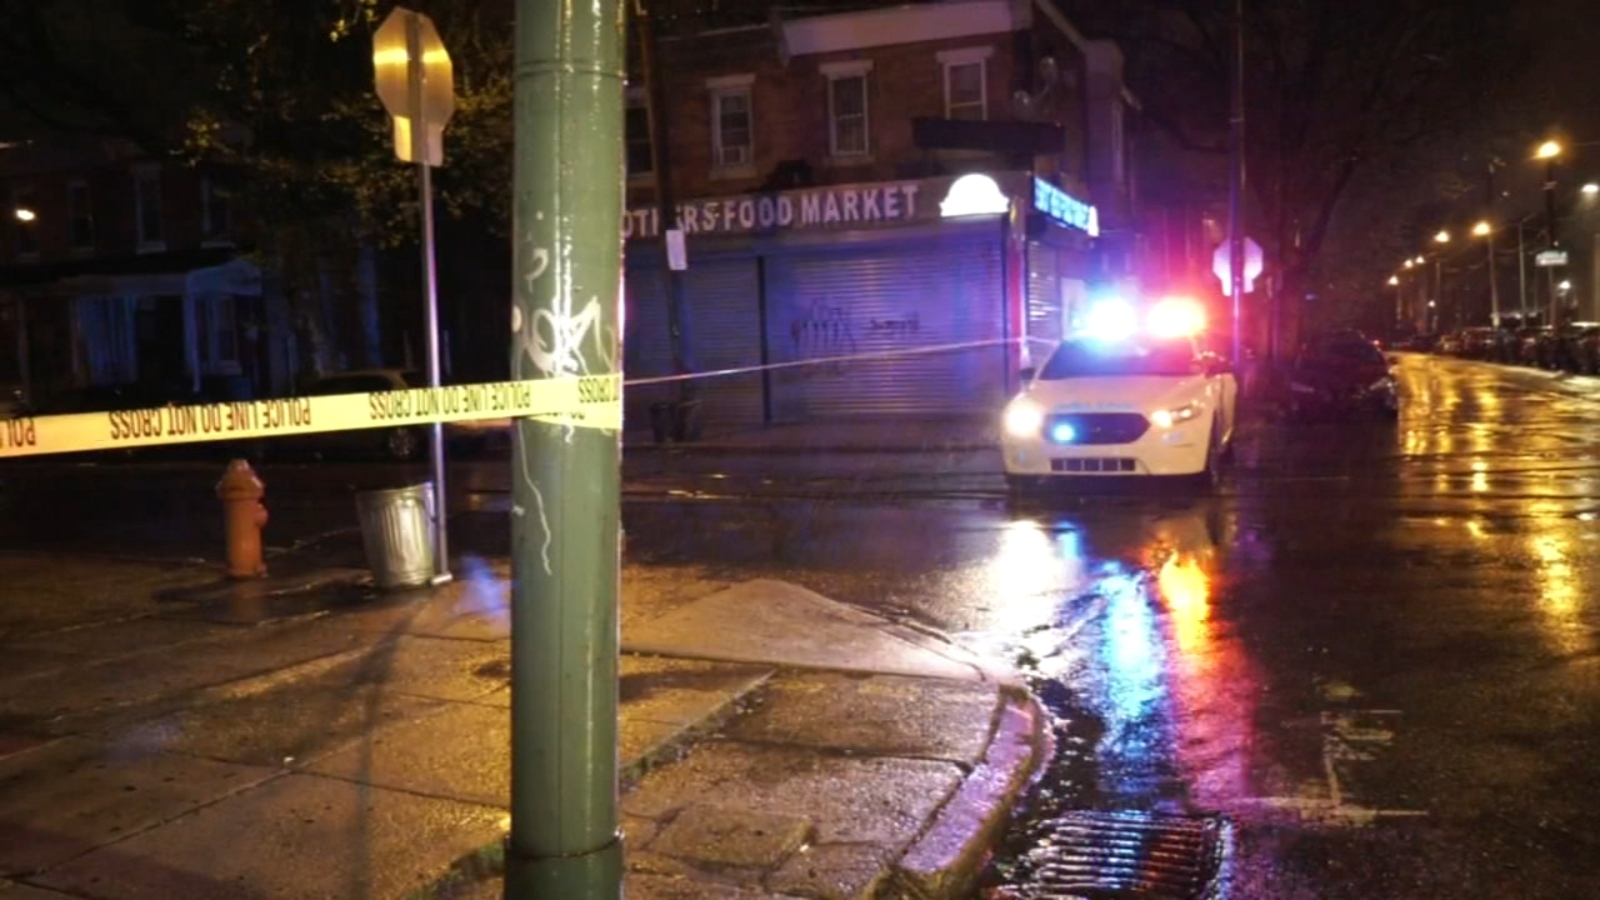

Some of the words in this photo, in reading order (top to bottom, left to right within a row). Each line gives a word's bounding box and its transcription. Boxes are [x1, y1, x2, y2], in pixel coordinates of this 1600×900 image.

[723, 195, 794, 231] FOOD
[801, 184, 919, 225] MARKET
[369, 390, 412, 420] CROSS
[415, 388, 440, 417] NOT
[443, 386, 459, 415] DO
[463, 385, 490, 412] LINE
[492, 383, 531, 411] POLICE
[578, 377, 611, 403] CROSS
[109, 408, 162, 440] CROSS
[167, 404, 197, 436] NOT
[202, 402, 223, 434] DO
[226, 401, 258, 431] LINE
[263, 398, 312, 429] POLICE
